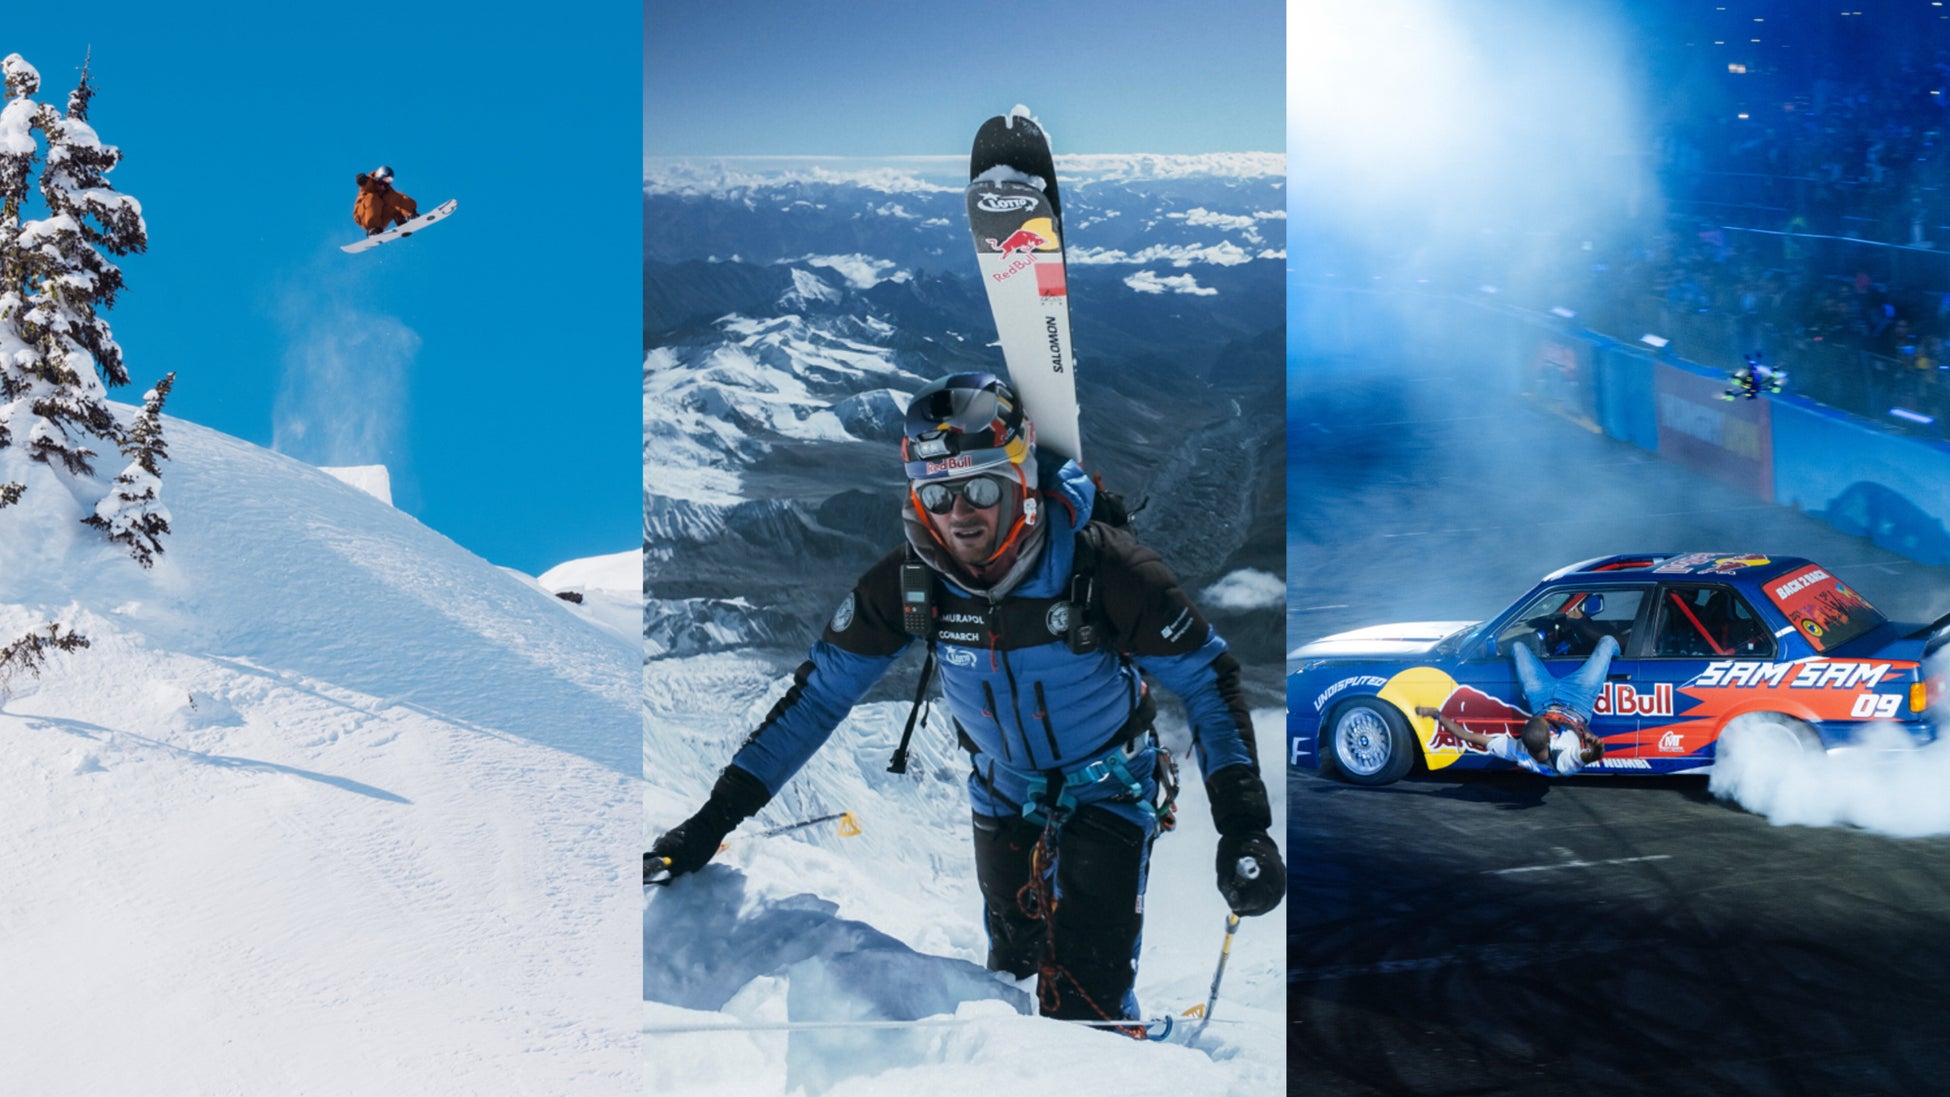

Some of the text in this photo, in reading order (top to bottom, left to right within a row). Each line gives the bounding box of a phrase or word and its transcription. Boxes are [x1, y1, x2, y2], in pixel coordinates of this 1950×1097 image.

[992, 253, 1037, 282] Red Bull
[1045, 315, 1064, 374] SALOMON
[926, 455, 971, 474] Red Bull
[1775, 569, 1830, 600] BACK 2 BACK
[1695, 661, 1894, 688] SAM SAM
[1313, 675, 1388, 711] UNDISPUTED
[1615, 684, 1673, 716] Bull
[1850, 694, 1903, 718] 09
